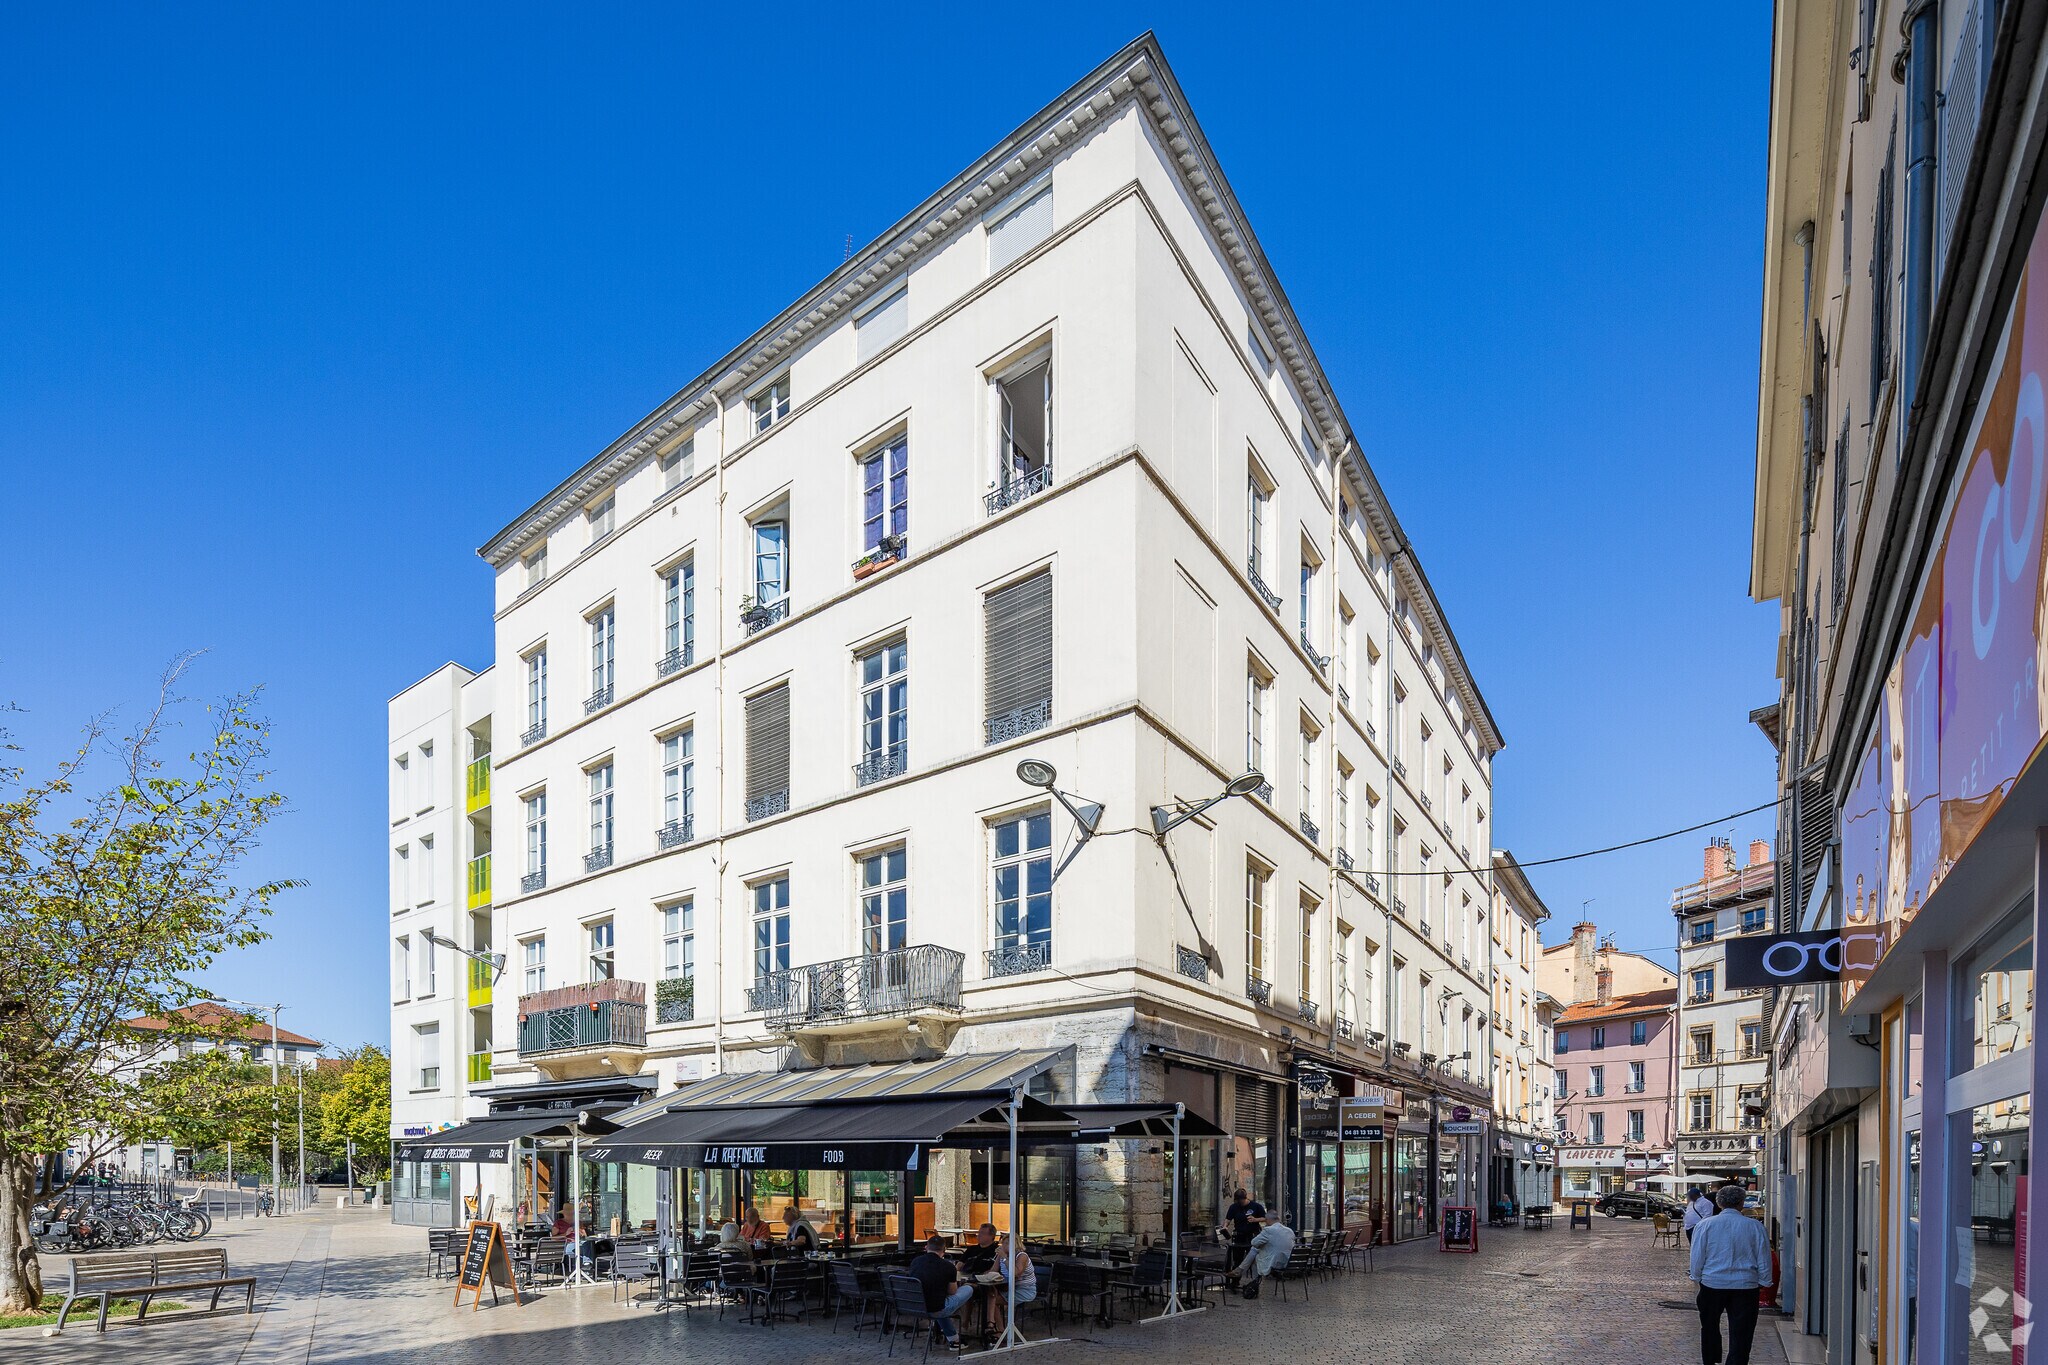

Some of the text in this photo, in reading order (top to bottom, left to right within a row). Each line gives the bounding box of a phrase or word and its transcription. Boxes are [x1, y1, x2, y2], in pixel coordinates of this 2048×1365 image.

[1960, 711, 2004, 807] PETIT
[2012, 655, 2034, 721] PR
[403, 1127, 427, 1136] matmut
[423, 1147, 473, 1159] 20 BIÈRES PRESSIONS
[488, 1148, 504, 1159] TAPAS
[642, 1149, 663, 1161] BEER
[704, 1146, 767, 1164] LA RAFFINERIE
[823, 1150, 844, 1163] FOOD
[1566, 1149, 1616, 1160] LAVERIE
